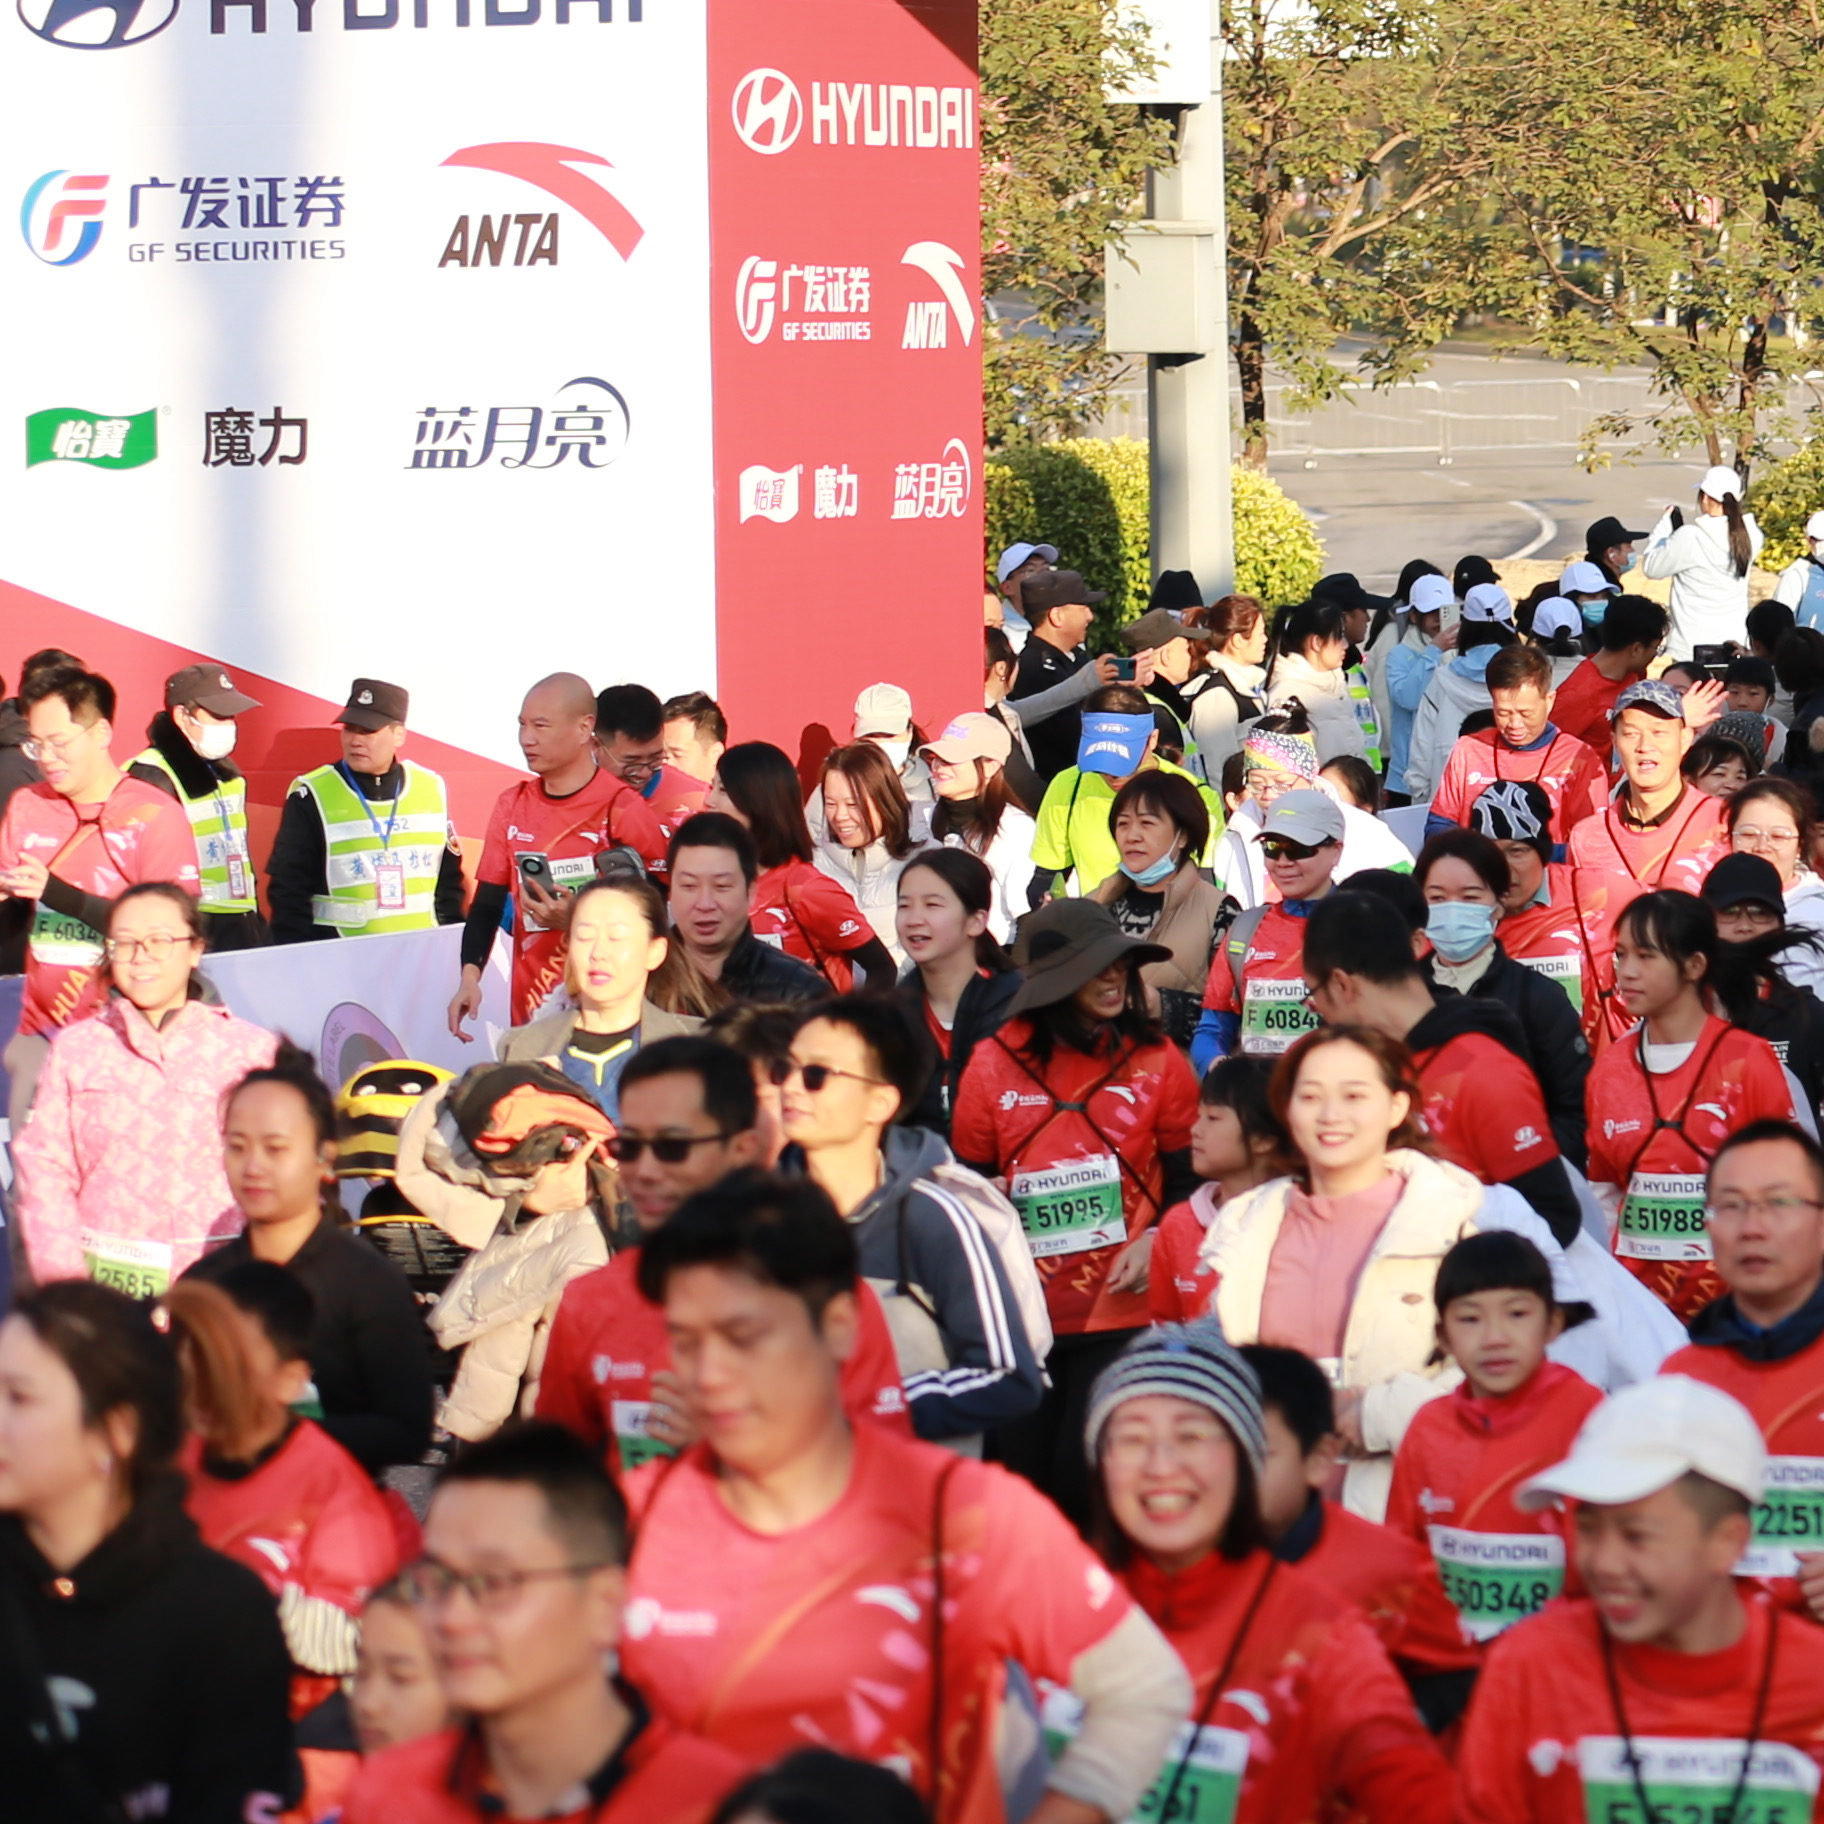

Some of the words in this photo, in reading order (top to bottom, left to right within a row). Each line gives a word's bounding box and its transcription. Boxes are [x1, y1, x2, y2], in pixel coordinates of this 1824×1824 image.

[811, 82, 975, 150] HYUNDAI
[128, 176, 346, 230] 广发证券
[128, 240, 167, 263] GF
[174, 239, 346, 263] SECURITIES
[437, 212, 560, 269] ANTA
[781, 265, 871, 314] 广发证券
[781, 321, 801, 342] GF
[802, 320, 871, 342] SECURITIES
[901, 301, 947, 351] ANTA
[201, 405, 309, 469] 魔力
[403, 398, 620, 472] 蓝月亮
[812, 463, 859, 521] 魔力
[890, 456, 969, 522] 蓝月亮
[38, 921, 48, 939] F
[54, 920, 99, 941] 6034
[1268, 985, 1312, 997] HYUND
[1248, 1010, 1258, 1027] F
[1038, 1169, 1108, 1190] HYUNDAI
[1643, 1181, 1706, 1194] HYUNDA
[1018, 1207, 1031, 1231] E
[1036, 1195, 1104, 1230] 51995
[1623, 1205, 1633, 1229] E
[1638, 1207, 1706, 1233] 51988
[99, 1267, 155, 1297] 2585
[1755, 1504, 1824, 1538] 2251
[1455, 1580, 1550, 1615] 50348
